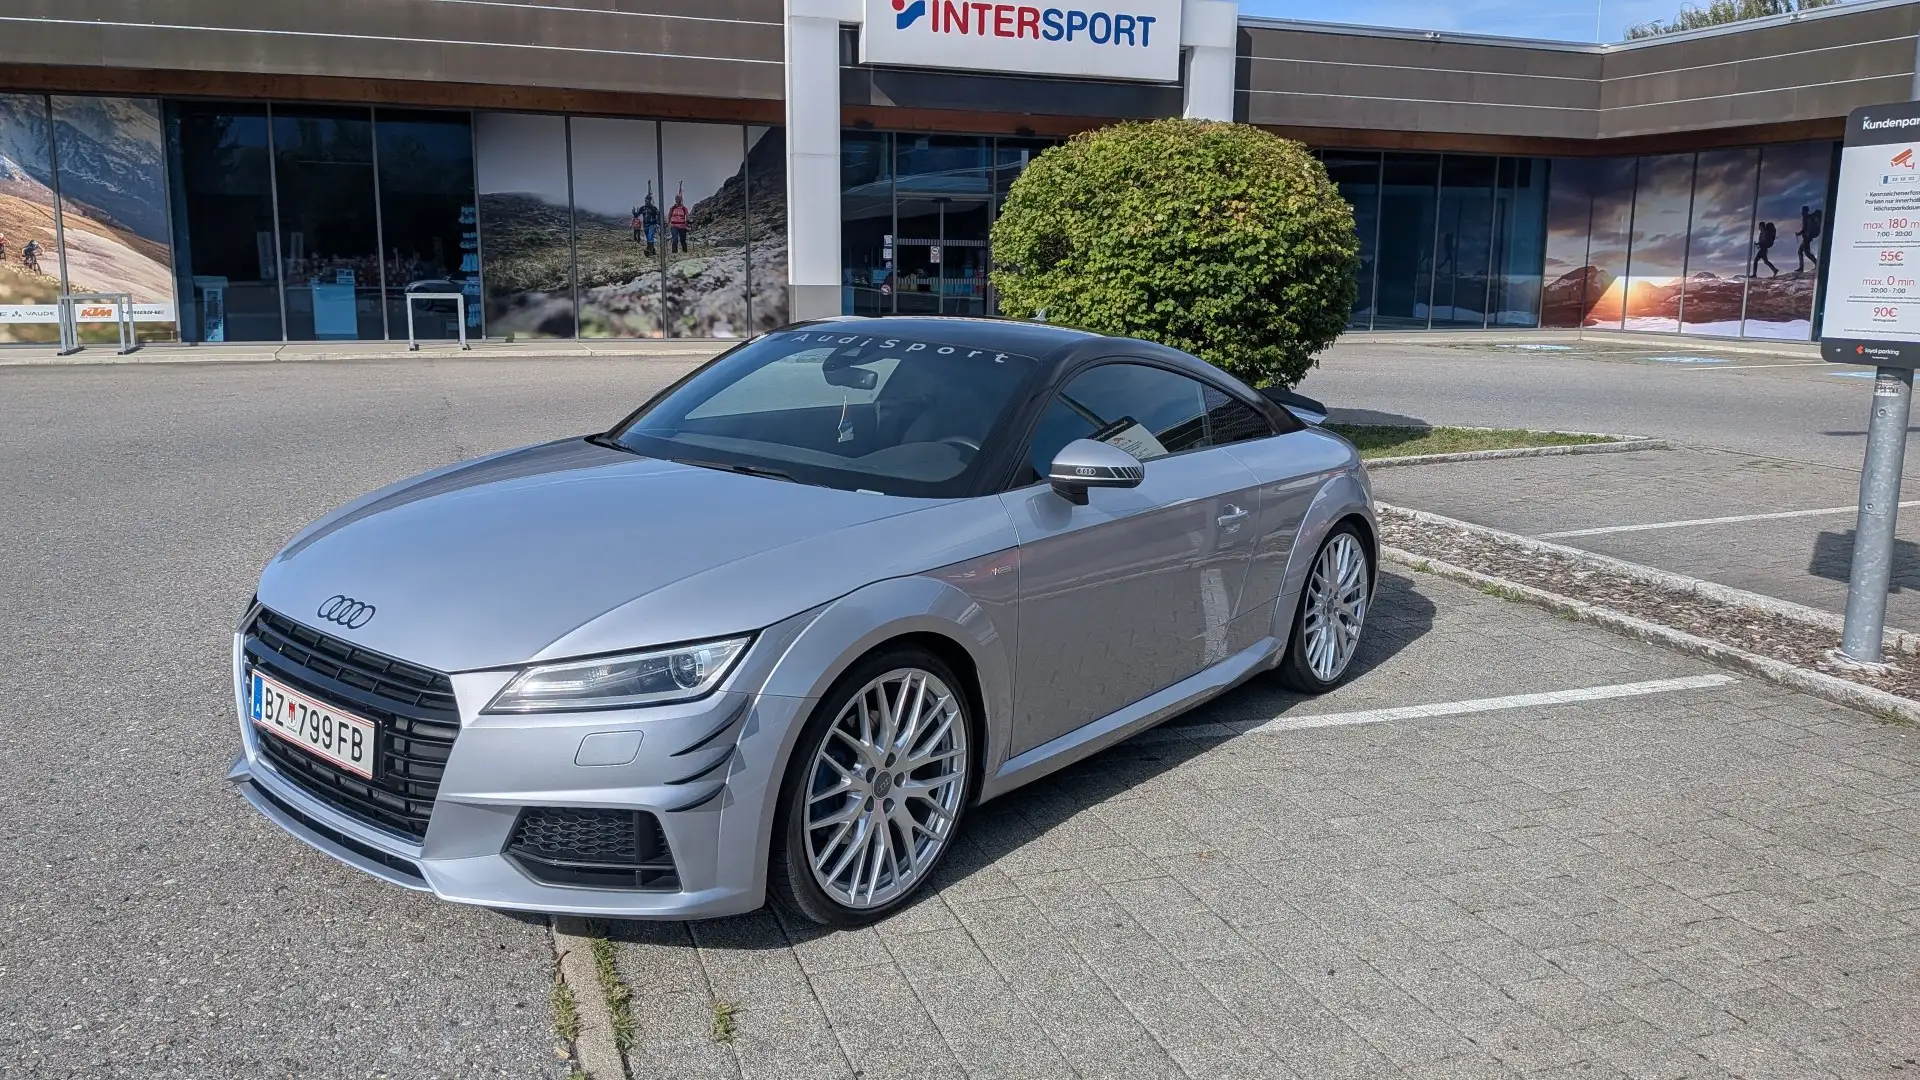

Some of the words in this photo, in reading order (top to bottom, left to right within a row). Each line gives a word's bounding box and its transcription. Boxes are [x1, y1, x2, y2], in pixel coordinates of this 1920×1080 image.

[931, 0, 1157, 48] INTERSPORT
[1863, 222, 1885, 230] max.
[1888, 218, 1908, 229] 180
[1880, 250, 1904, 262] 55€
[1862, 278, 1884, 286] max.
[1886, 275, 1895, 286] 0
[1897, 277, 1917, 286] min.
[80, 307, 113, 317] KTM
[1873, 306, 1898, 318] 90€
[1877, 348, 1900, 356] parking
[265, 686, 285, 728] BZ
